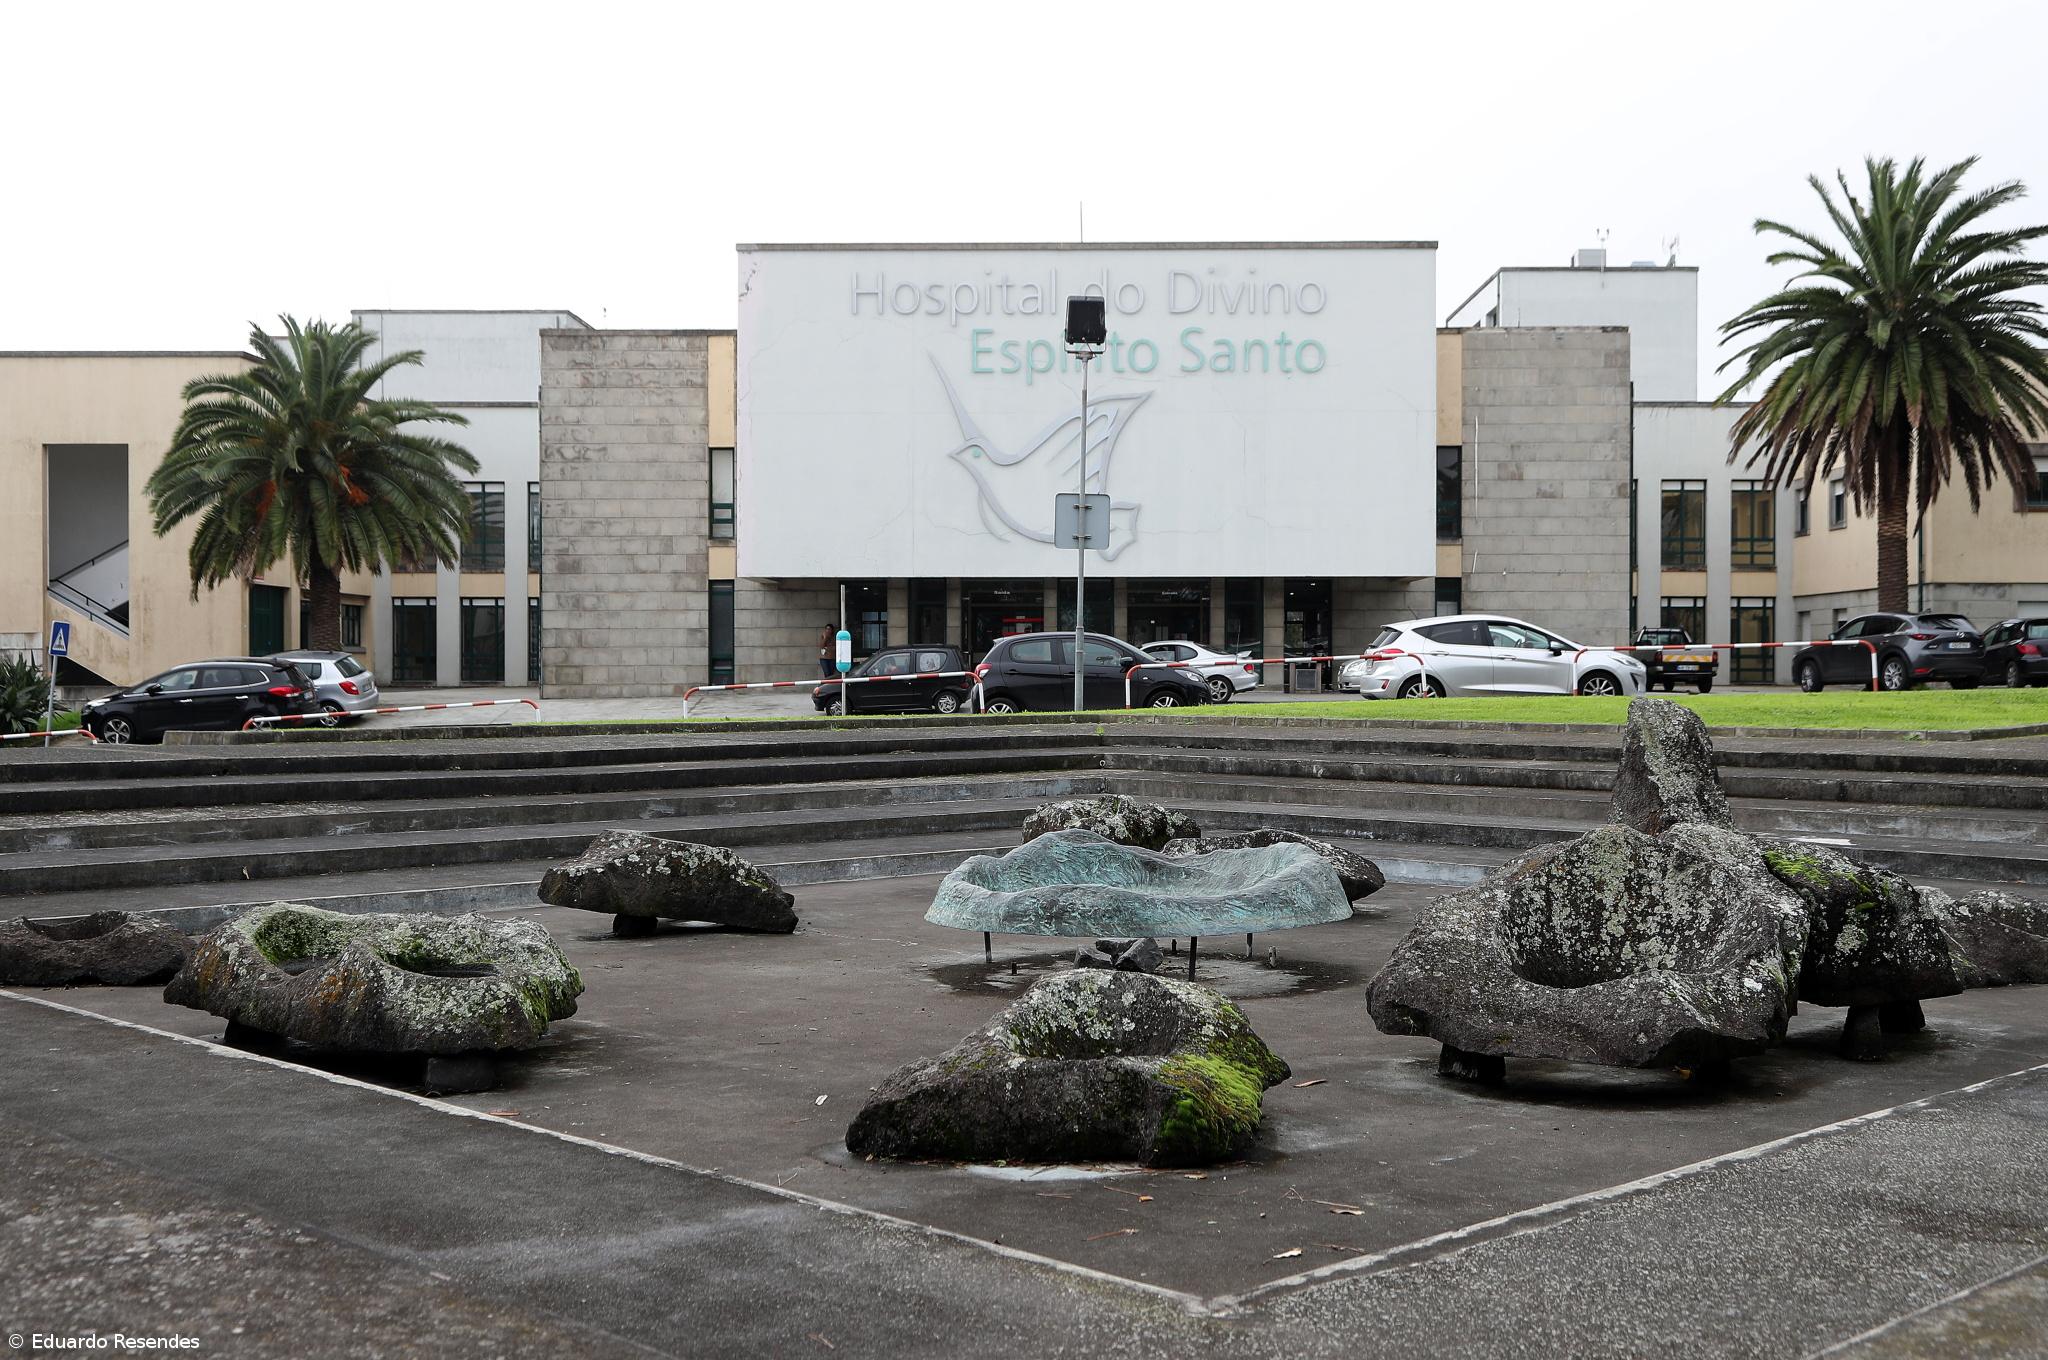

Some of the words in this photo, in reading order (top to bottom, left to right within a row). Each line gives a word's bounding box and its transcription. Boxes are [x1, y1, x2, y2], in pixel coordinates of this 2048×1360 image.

[849, 268, 1058, 326] Hospital
[1083, 268, 1146, 315] do
[1167, 267, 1327, 315] Divino
[1179, 326, 1327, 374] Santo
